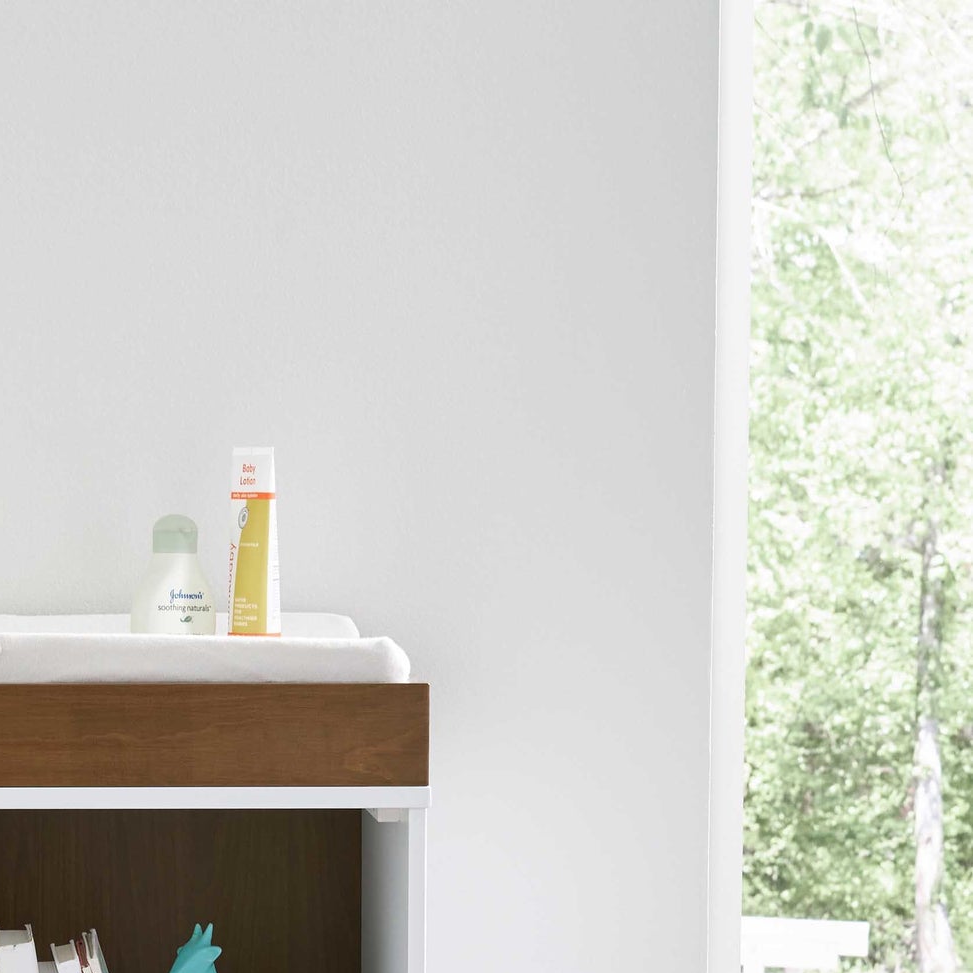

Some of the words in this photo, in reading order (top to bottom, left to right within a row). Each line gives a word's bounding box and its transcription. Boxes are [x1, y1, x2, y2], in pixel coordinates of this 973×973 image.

[242, 463, 256, 475] Baby
[239, 476, 256, 485] Lotion
[169, 589, 203, 604] Johnson's
[157, 604, 186, 613] soothing
